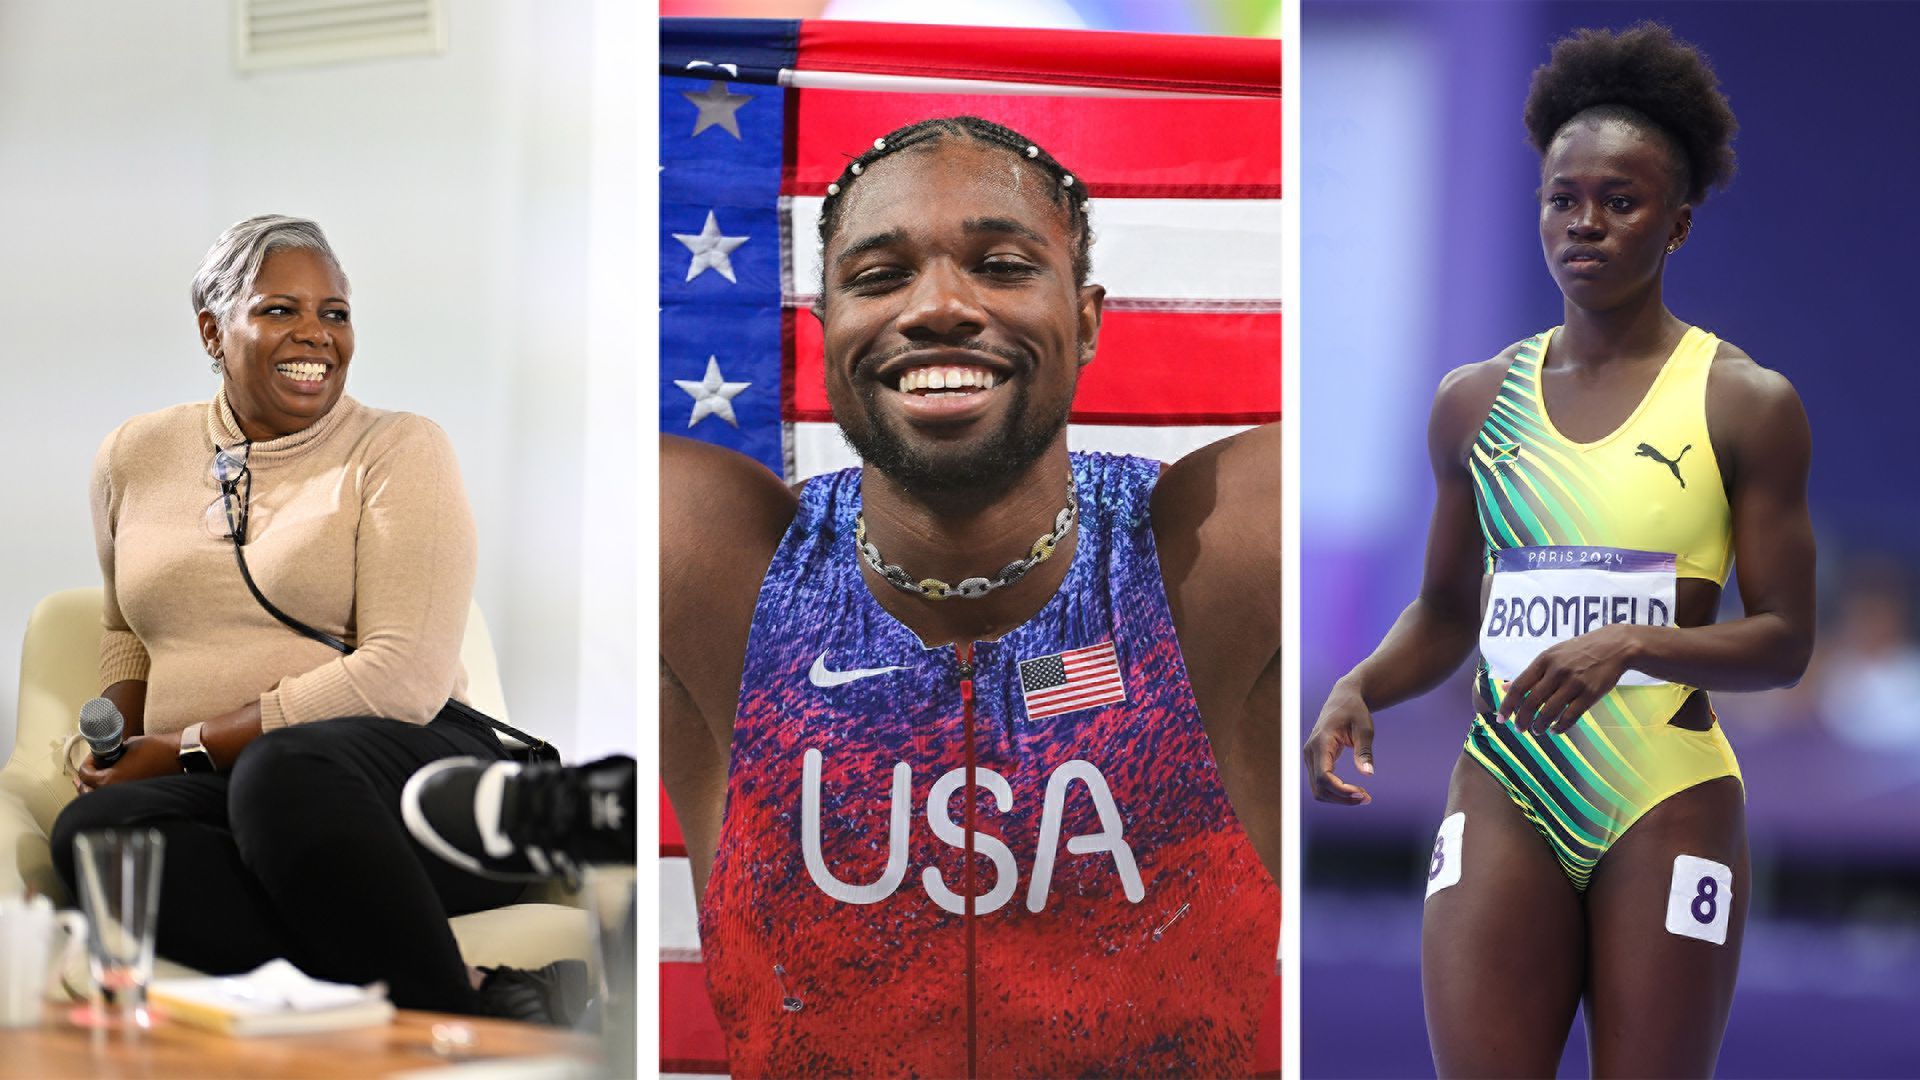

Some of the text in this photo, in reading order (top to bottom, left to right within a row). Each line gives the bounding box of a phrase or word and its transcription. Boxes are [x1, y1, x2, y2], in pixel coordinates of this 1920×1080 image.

[1580, 551, 1623, 564] 2024
[1487, 596, 1668, 637] BROMFIELD
[802, 748, 1145, 915] USA
[1691, 876, 1718, 924] 8
